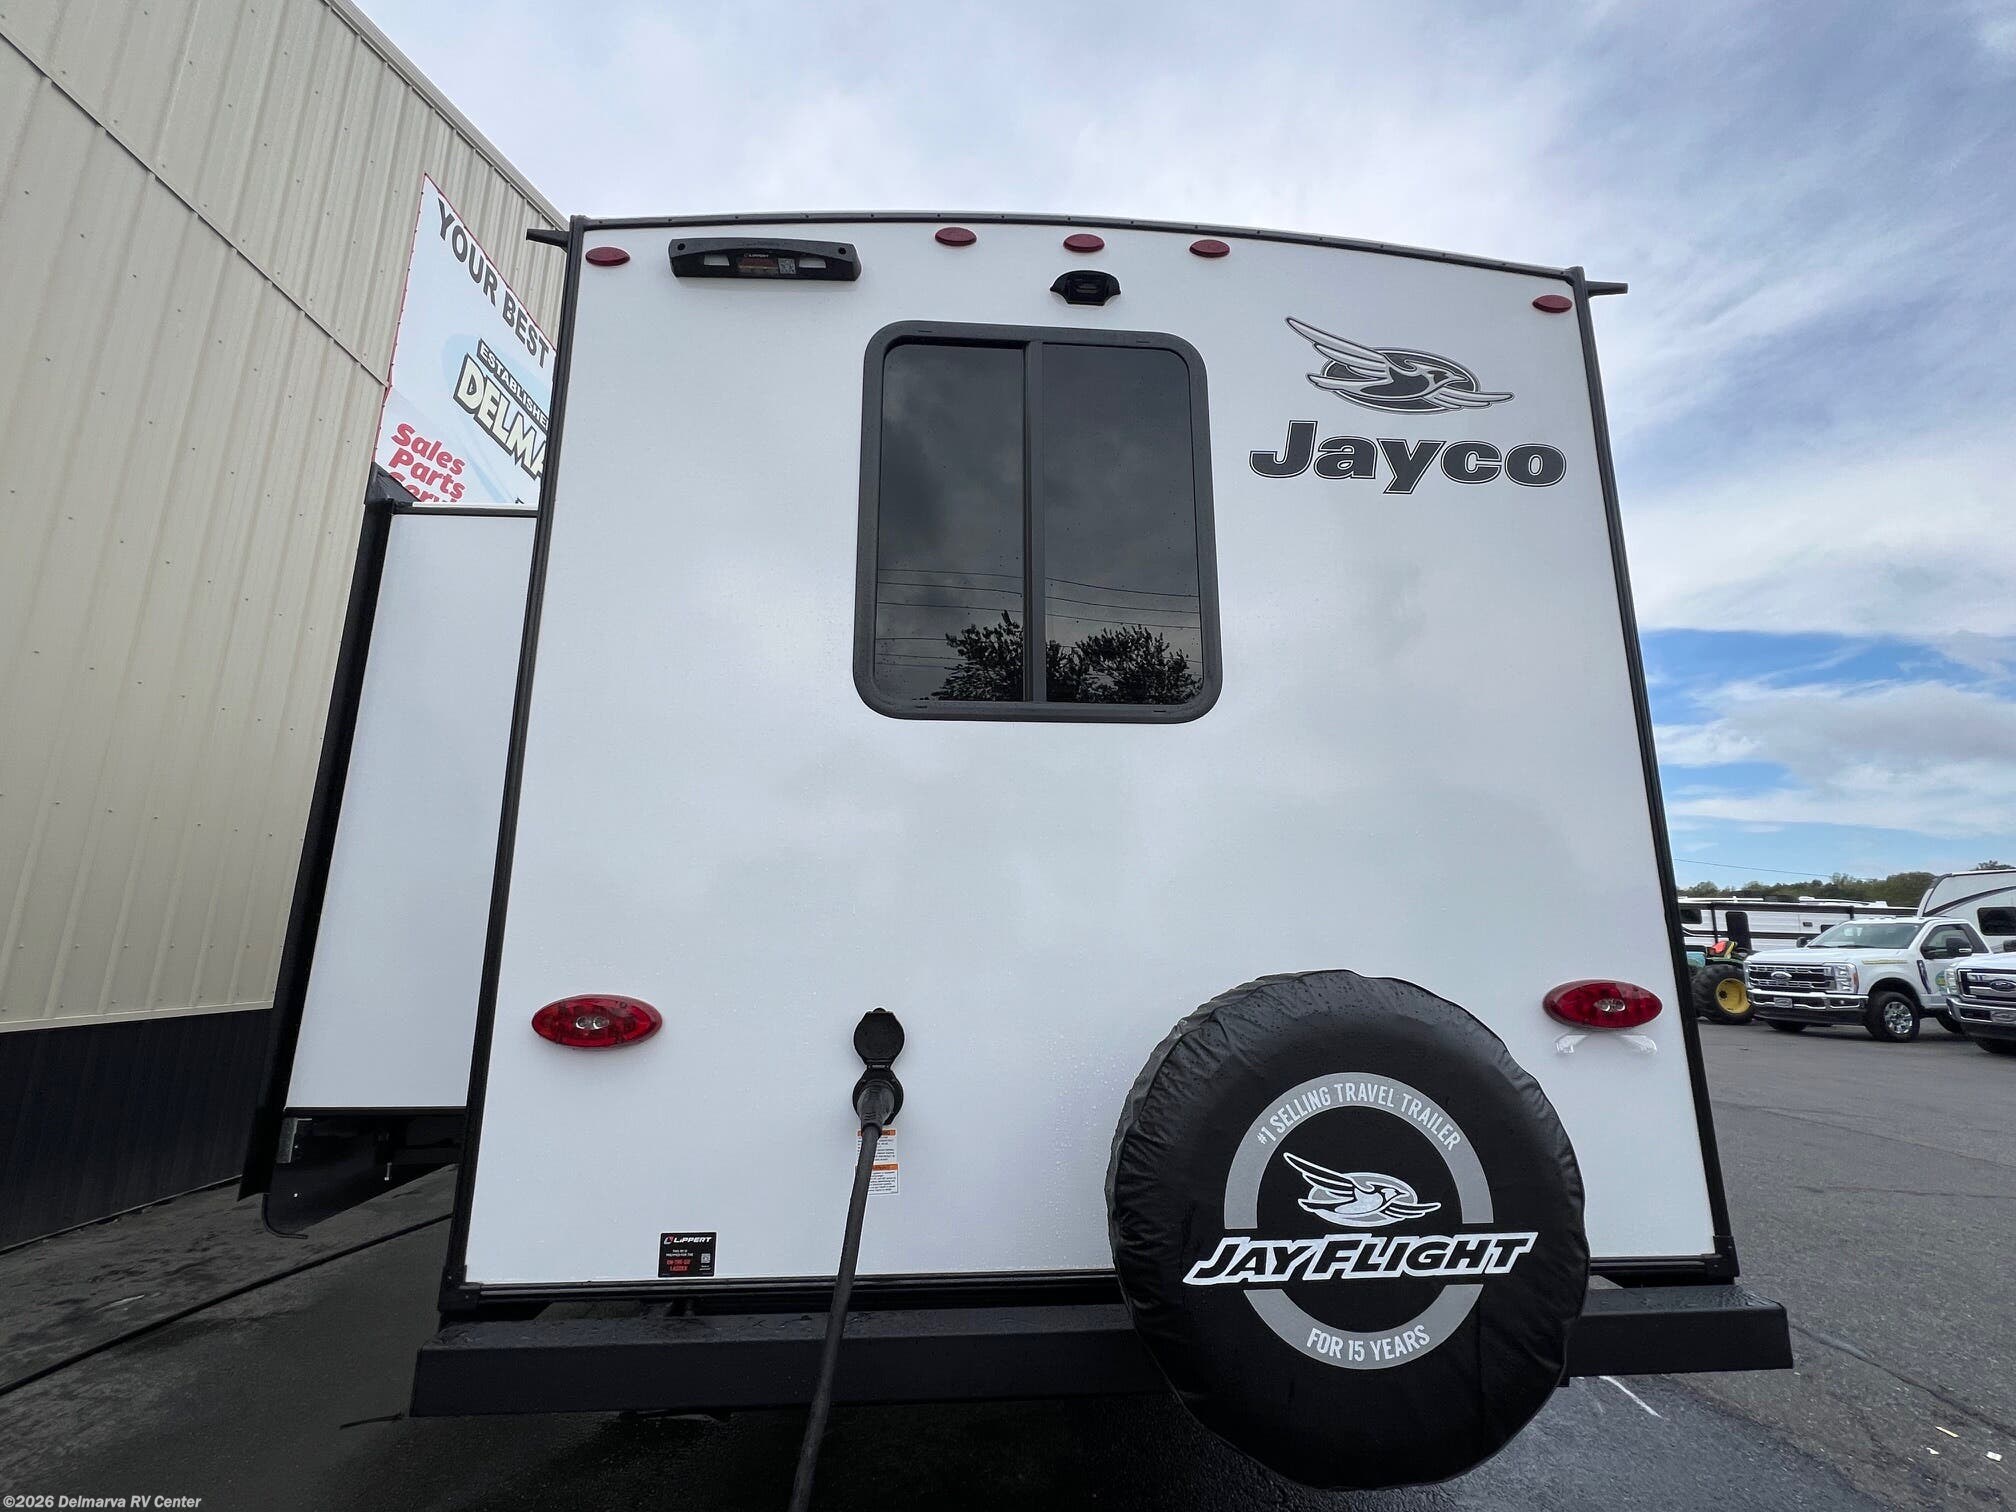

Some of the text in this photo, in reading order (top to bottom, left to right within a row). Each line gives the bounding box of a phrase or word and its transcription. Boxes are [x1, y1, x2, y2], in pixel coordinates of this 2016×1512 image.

[438, 198, 550, 368] YOUR BEST
[388, 447, 466, 500] Parts
[391, 423, 466, 476] Sales
[1249, 420, 1567, 494] Jayco
[1256, 1082, 1461, 1151] #1 SELLING TRAVEL TRAILER
[1306, 1324, 1431, 1362] FOR 15 YEARS
